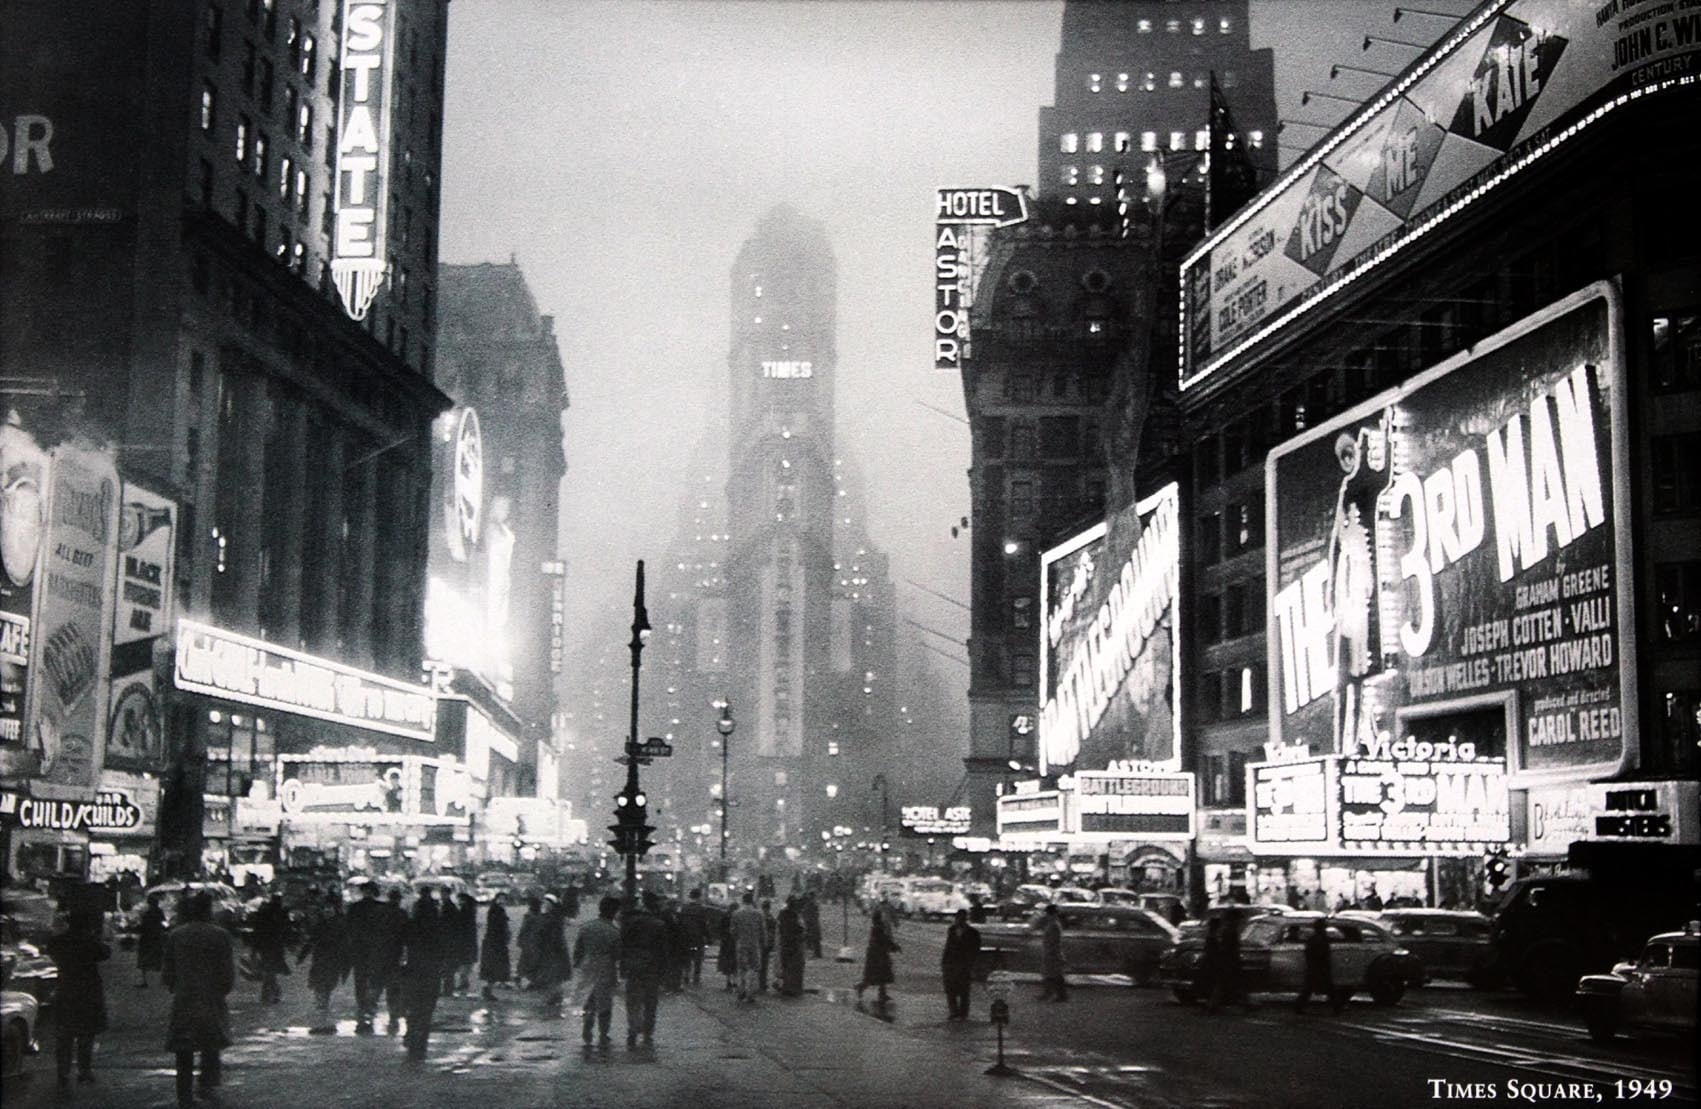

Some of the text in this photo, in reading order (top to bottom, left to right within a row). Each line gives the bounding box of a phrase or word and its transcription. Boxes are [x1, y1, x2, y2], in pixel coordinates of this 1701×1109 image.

[1612, 26, 1652, 71] JOHN
[1656, 21, 1673, 51] C.
[1472, 33, 1540, 137] KATE
[1632, 55, 1692, 86] CENTURY
[337, 5, 383, 257] STATE
[937, 190, 1004, 216] HOTEL
[1300, 180, 1348, 262] KISS
[935, 227, 958, 361] ASTOR
[762, 361, 812, 379] TIMES
[1274, 558, 1337, 715] THE
[1390, 449, 1485, 657] 3RD
[1486, 364, 1605, 584] MAN
[1516, 564, 1610, 609] GRAHAM GREENE
[0, 621, 29, 658] AFE
[1461, 596, 1611, 656] JOSEPH COTTEN VALLI
[1446, 658, 1490, 692] WELLES
[1495, 646, 1547, 683] TREVOR
[1550, 634, 1613, 676] HOWARD
[1363, 735, 1476, 762] Victoria
[1528, 707, 1621, 747] CAROL REED
[1081, 776, 1189, 796] BATTLEGROUND
[1341, 776, 1382, 804] THE
[1379, 770, 1436, 815] 3RD
[1436, 774, 1509, 814] MAN
[83, 804, 134, 827] CHILDS
